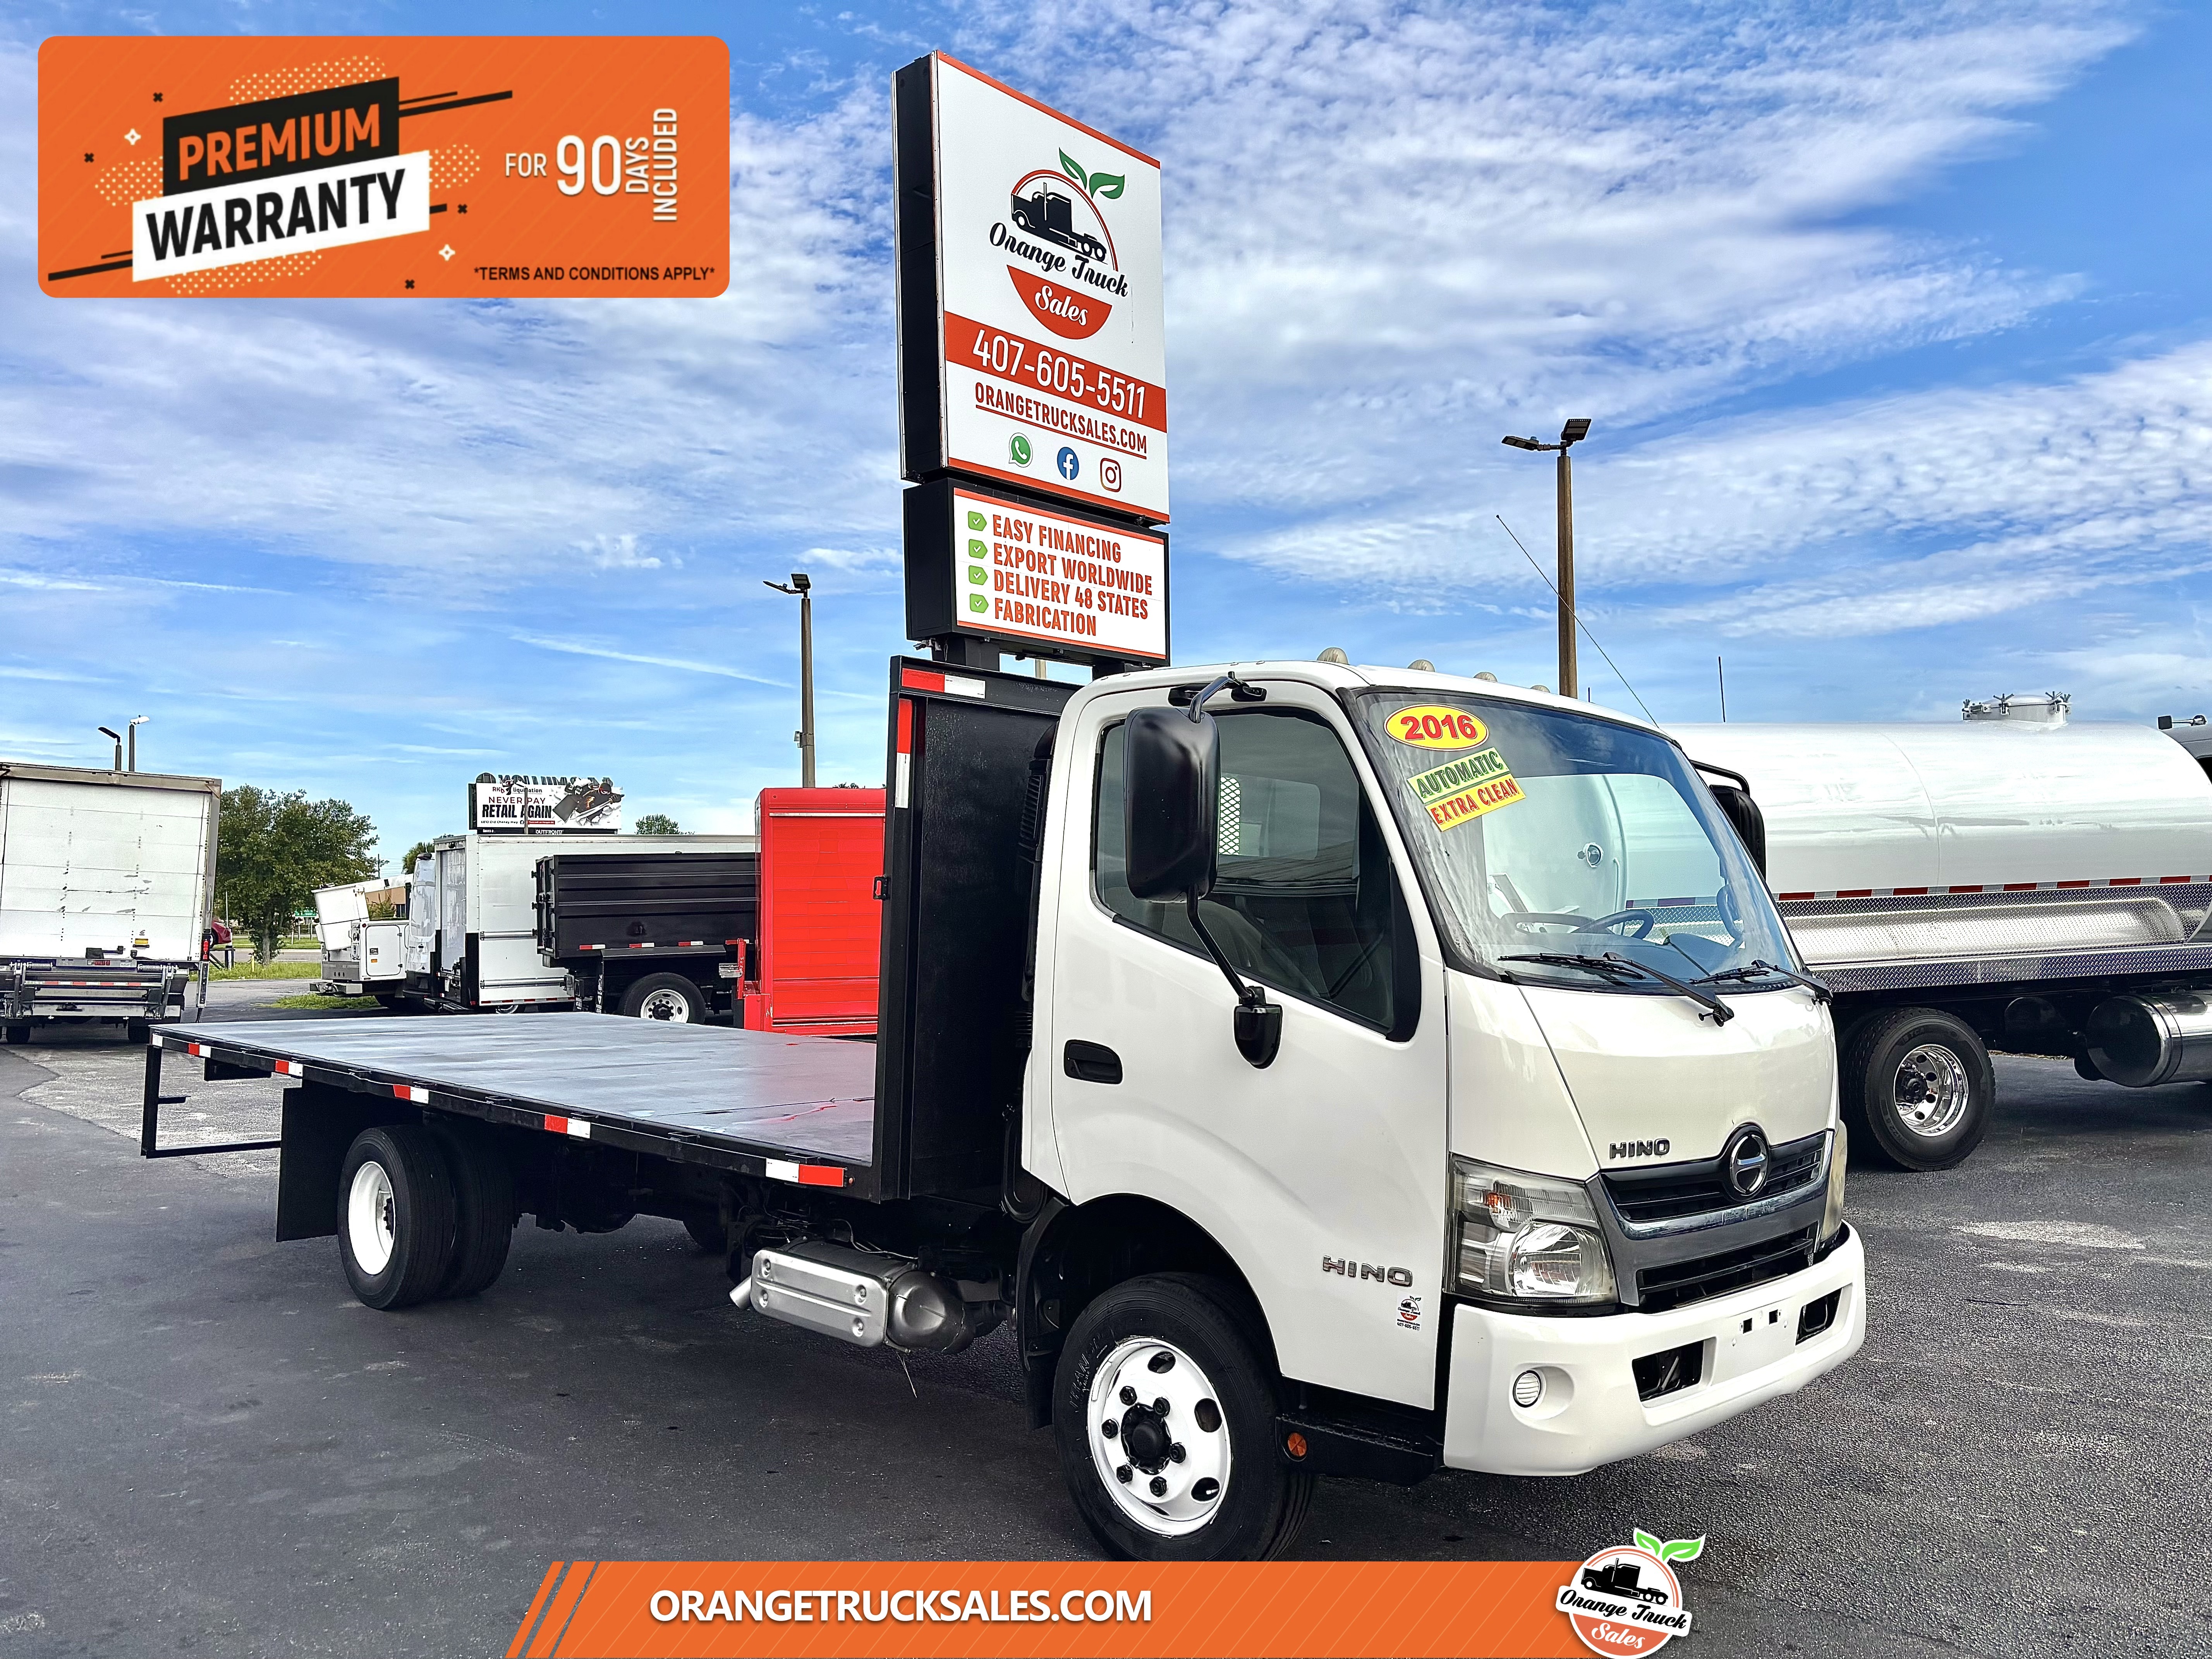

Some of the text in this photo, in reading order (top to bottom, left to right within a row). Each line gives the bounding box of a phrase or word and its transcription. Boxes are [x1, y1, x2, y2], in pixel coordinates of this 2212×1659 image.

[990, 222, 1128, 297] Orange Truck
[1035, 285, 1088, 325] Sales
[973, 329, 1145, 419] 407-605-5511
[975, 382, 1147, 454] ORANGETRUCKSALES.COM
[993, 514, 1121, 563] EASY FINANCING
[994, 543, 1152, 595] EXPORT WORLDWIDE
[994, 569, 1148, 619] DELIVERY 48 STATES
[995, 598, 1096, 636] FABRICATION
[1401, 714, 1477, 740] 2016
[1417, 751, 1503, 799] AUTOMATIC
[482, 804, 552, 818] RETAIL AGAIN
[1431, 778, 1520, 825] EXTRA CLEAN
[1609, 1138, 1670, 1159] HINO
[1322, 1255, 1413, 1287] HINO
